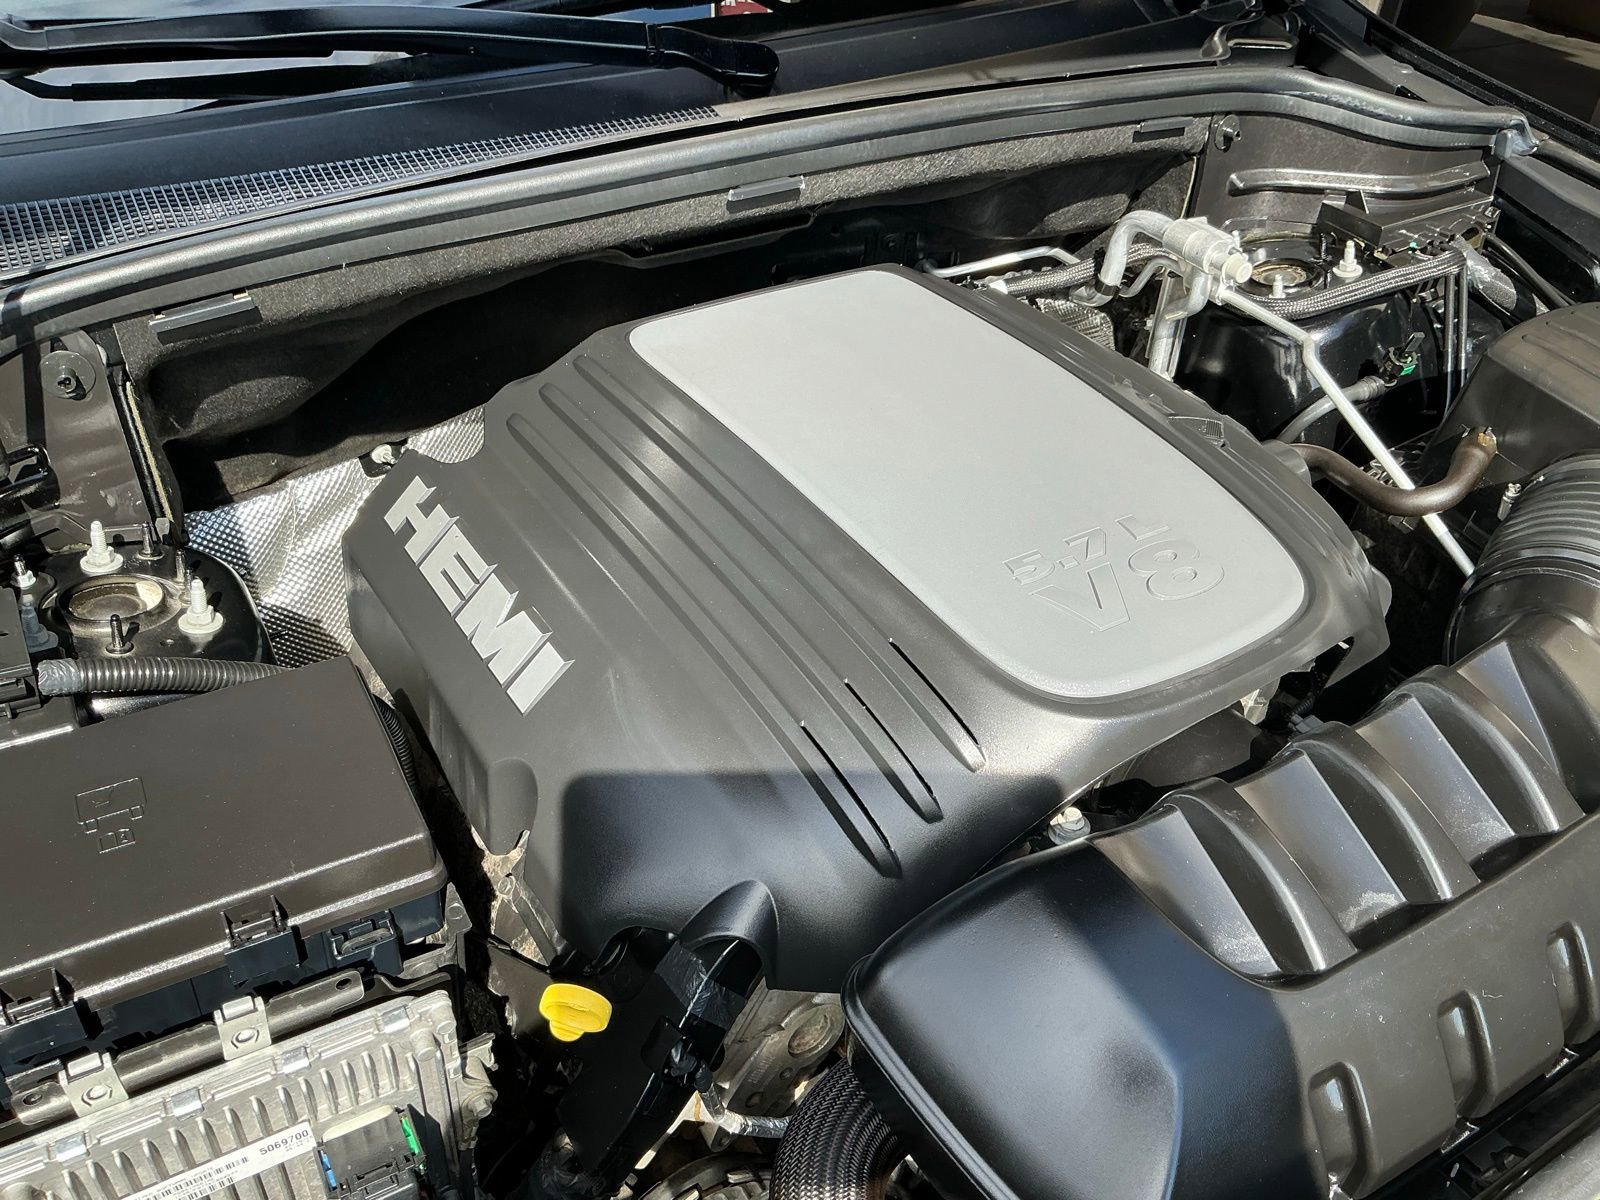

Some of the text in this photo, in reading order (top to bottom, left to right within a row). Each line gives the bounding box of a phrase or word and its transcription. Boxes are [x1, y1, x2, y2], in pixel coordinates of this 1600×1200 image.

[384, 475, 575, 717] HEMI
[1028, 538, 1225, 632] V8
[259, 1130, 309, 1156] 5069700
